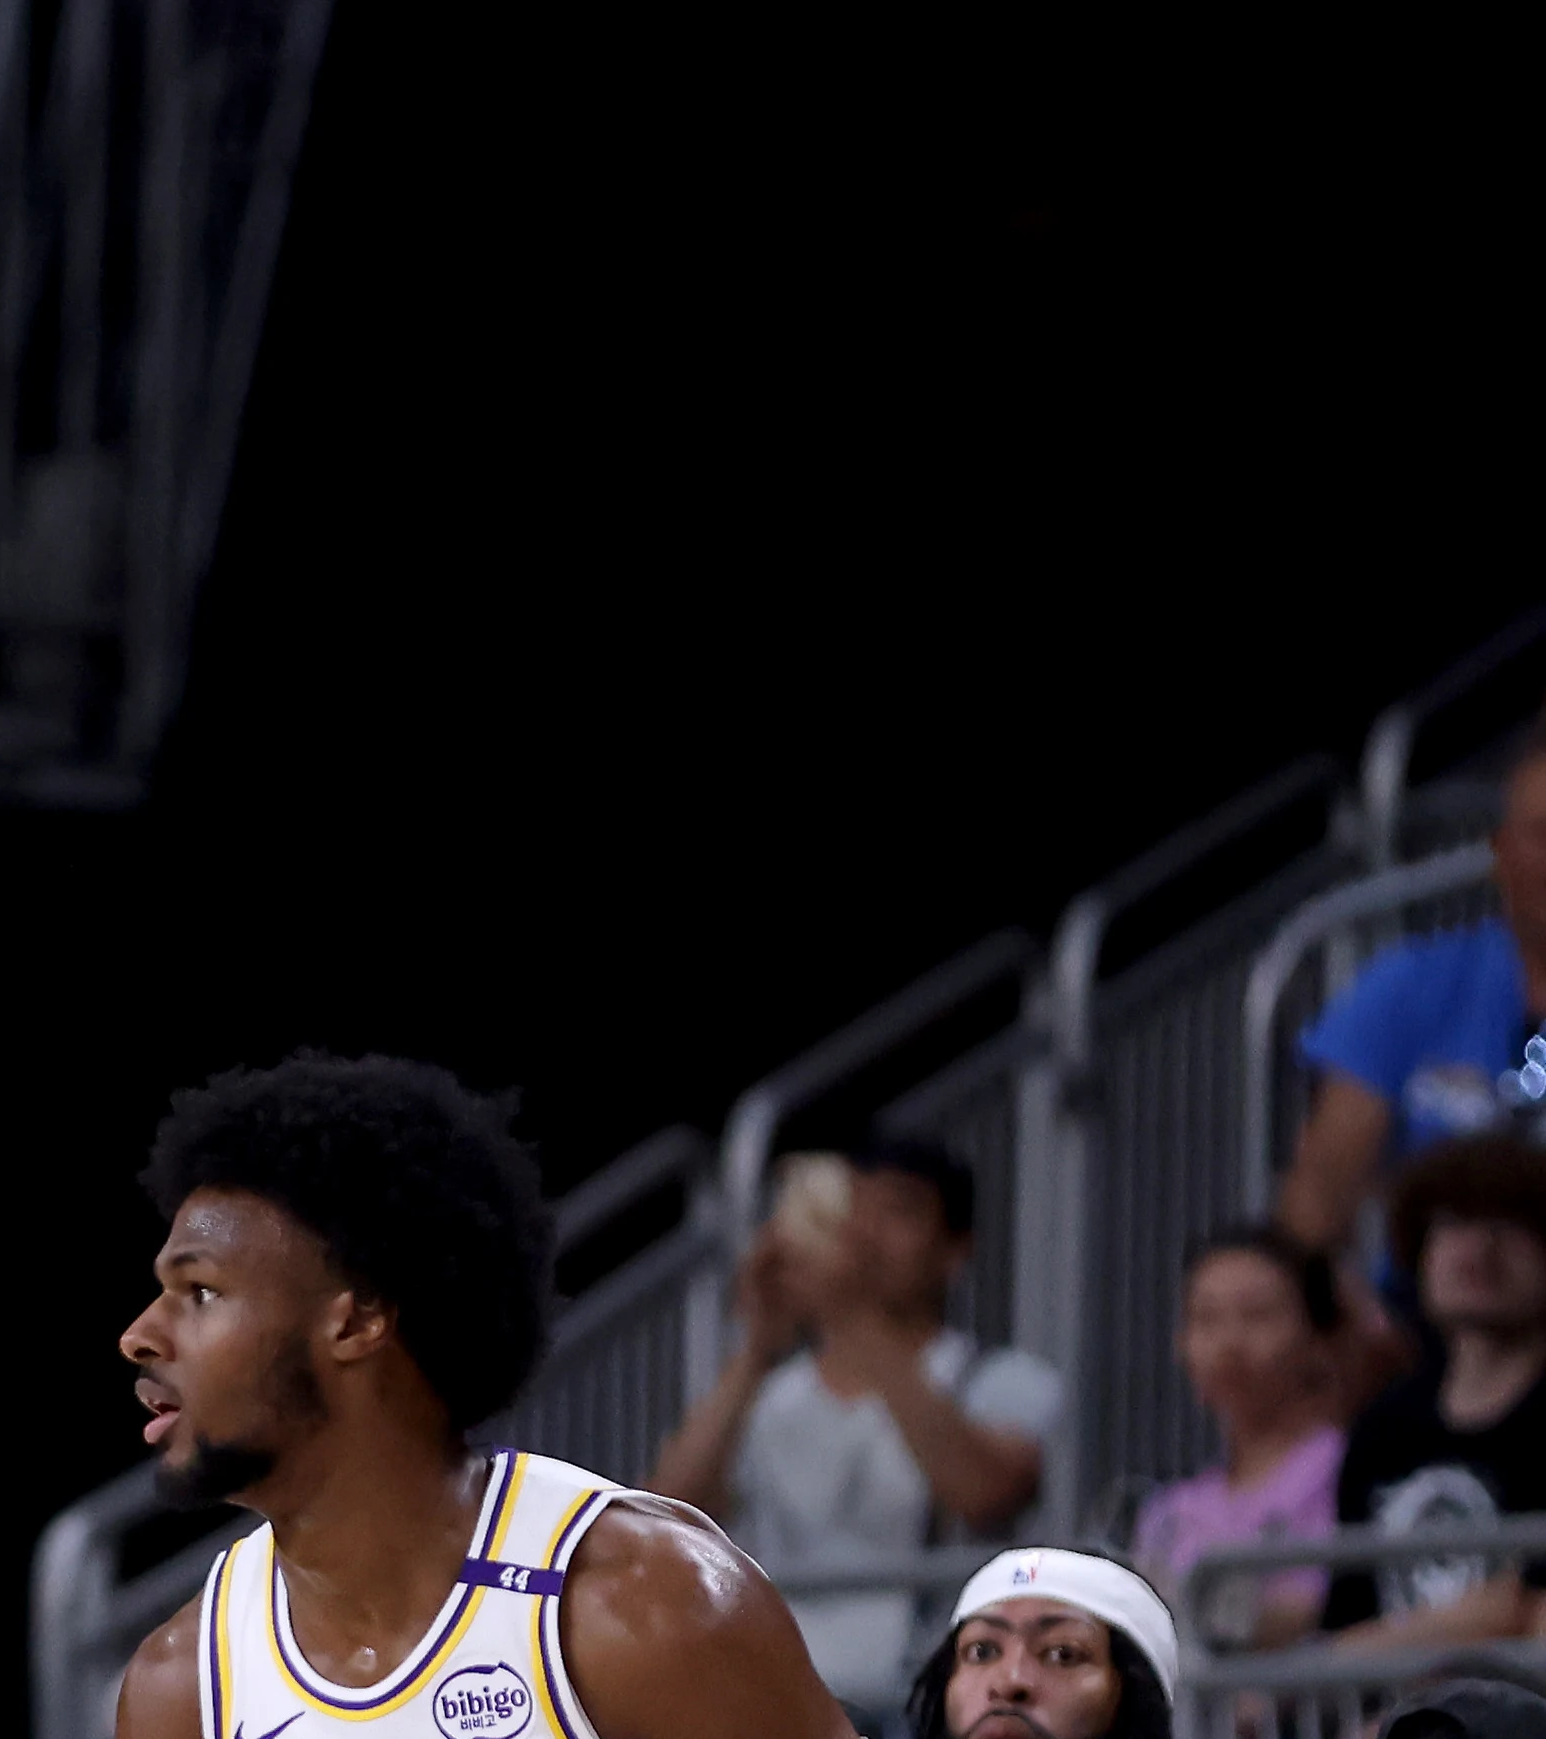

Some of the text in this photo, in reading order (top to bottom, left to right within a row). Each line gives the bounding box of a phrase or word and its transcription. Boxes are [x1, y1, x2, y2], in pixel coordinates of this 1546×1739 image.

[499, 1566, 531, 1592] 44
[441, 1685, 527, 1720] bibigo
[460, 1714, 497, 1732] 비비고
